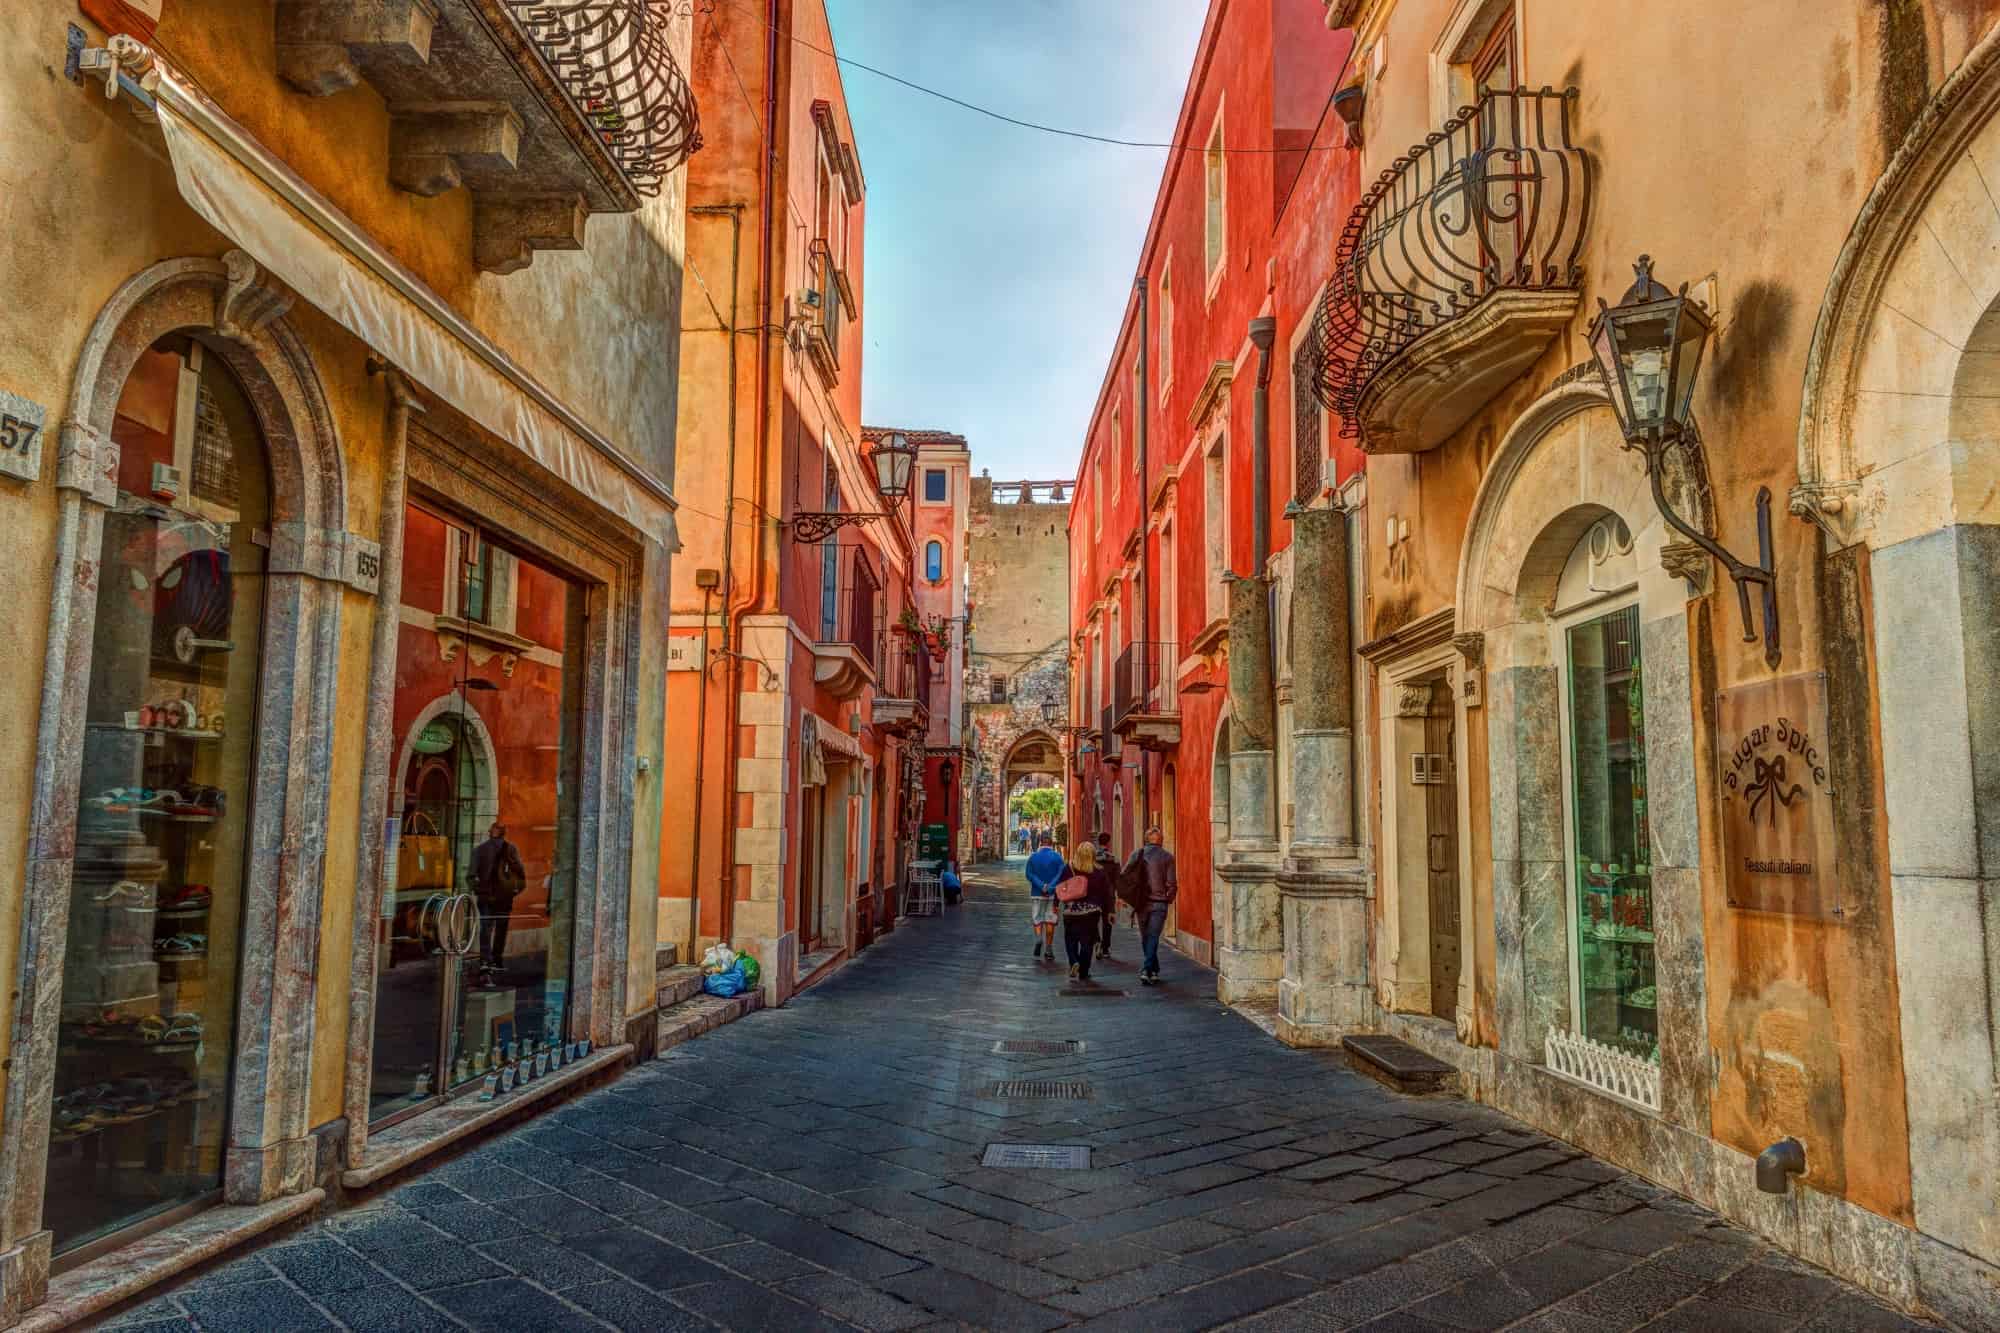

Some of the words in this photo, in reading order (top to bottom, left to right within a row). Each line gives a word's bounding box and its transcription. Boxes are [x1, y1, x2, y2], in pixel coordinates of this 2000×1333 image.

[357, 551, 378, 578] 155
[1724, 724, 1770, 789] Sugar
[1776, 717, 1825, 786] Spice
